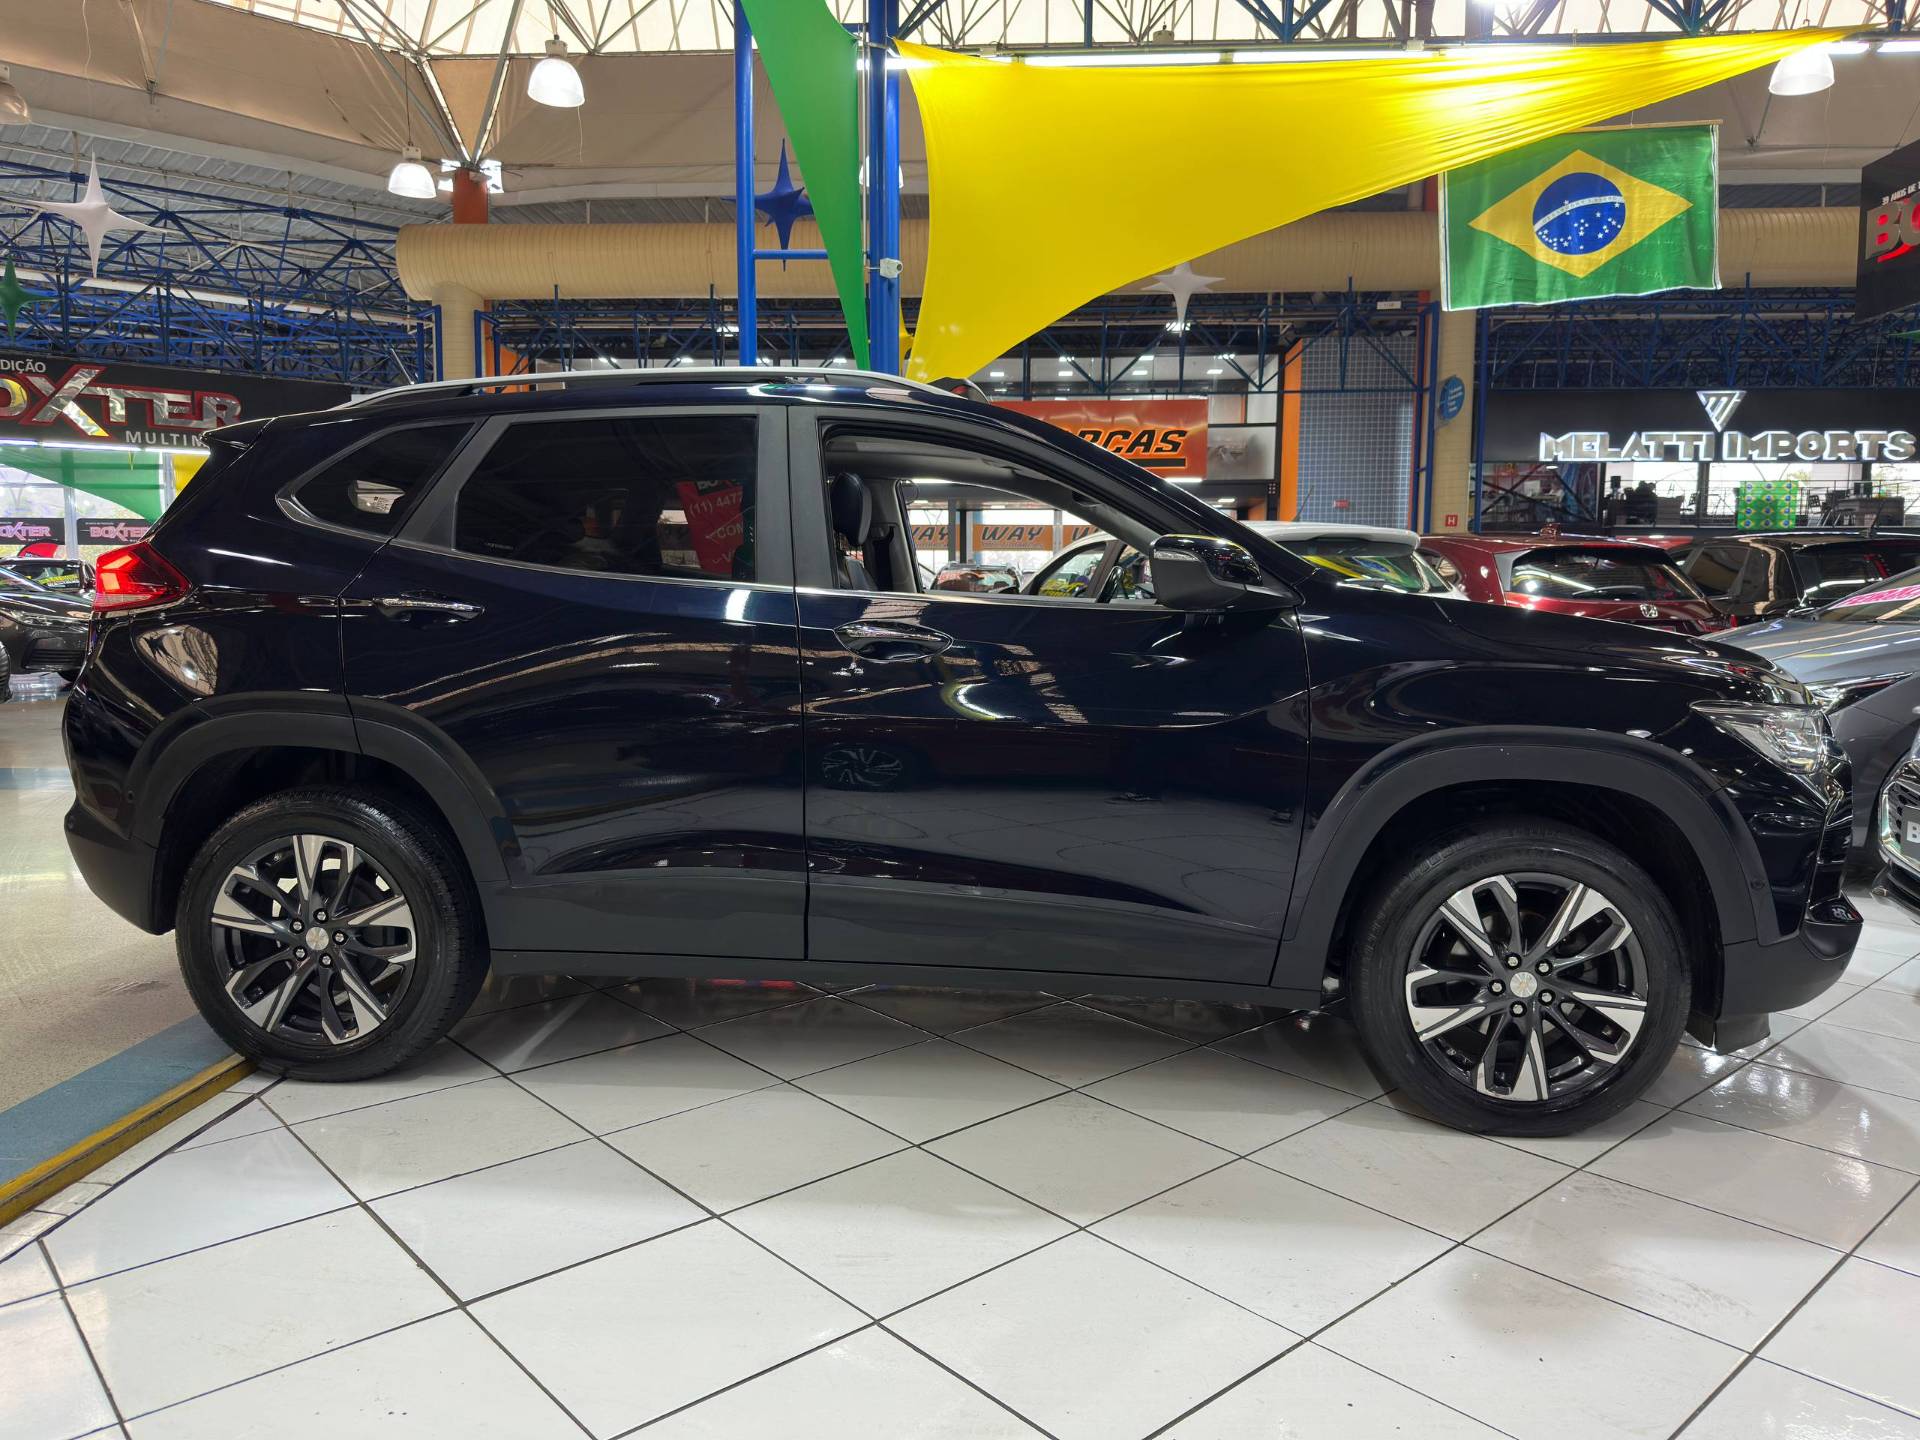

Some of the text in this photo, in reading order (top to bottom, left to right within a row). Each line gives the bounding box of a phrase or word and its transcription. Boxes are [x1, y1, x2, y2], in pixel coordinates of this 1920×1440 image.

[1539, 431, 1917, 462] MELATTI IMPORTS
[982, 526, 1043, 541] WAY
